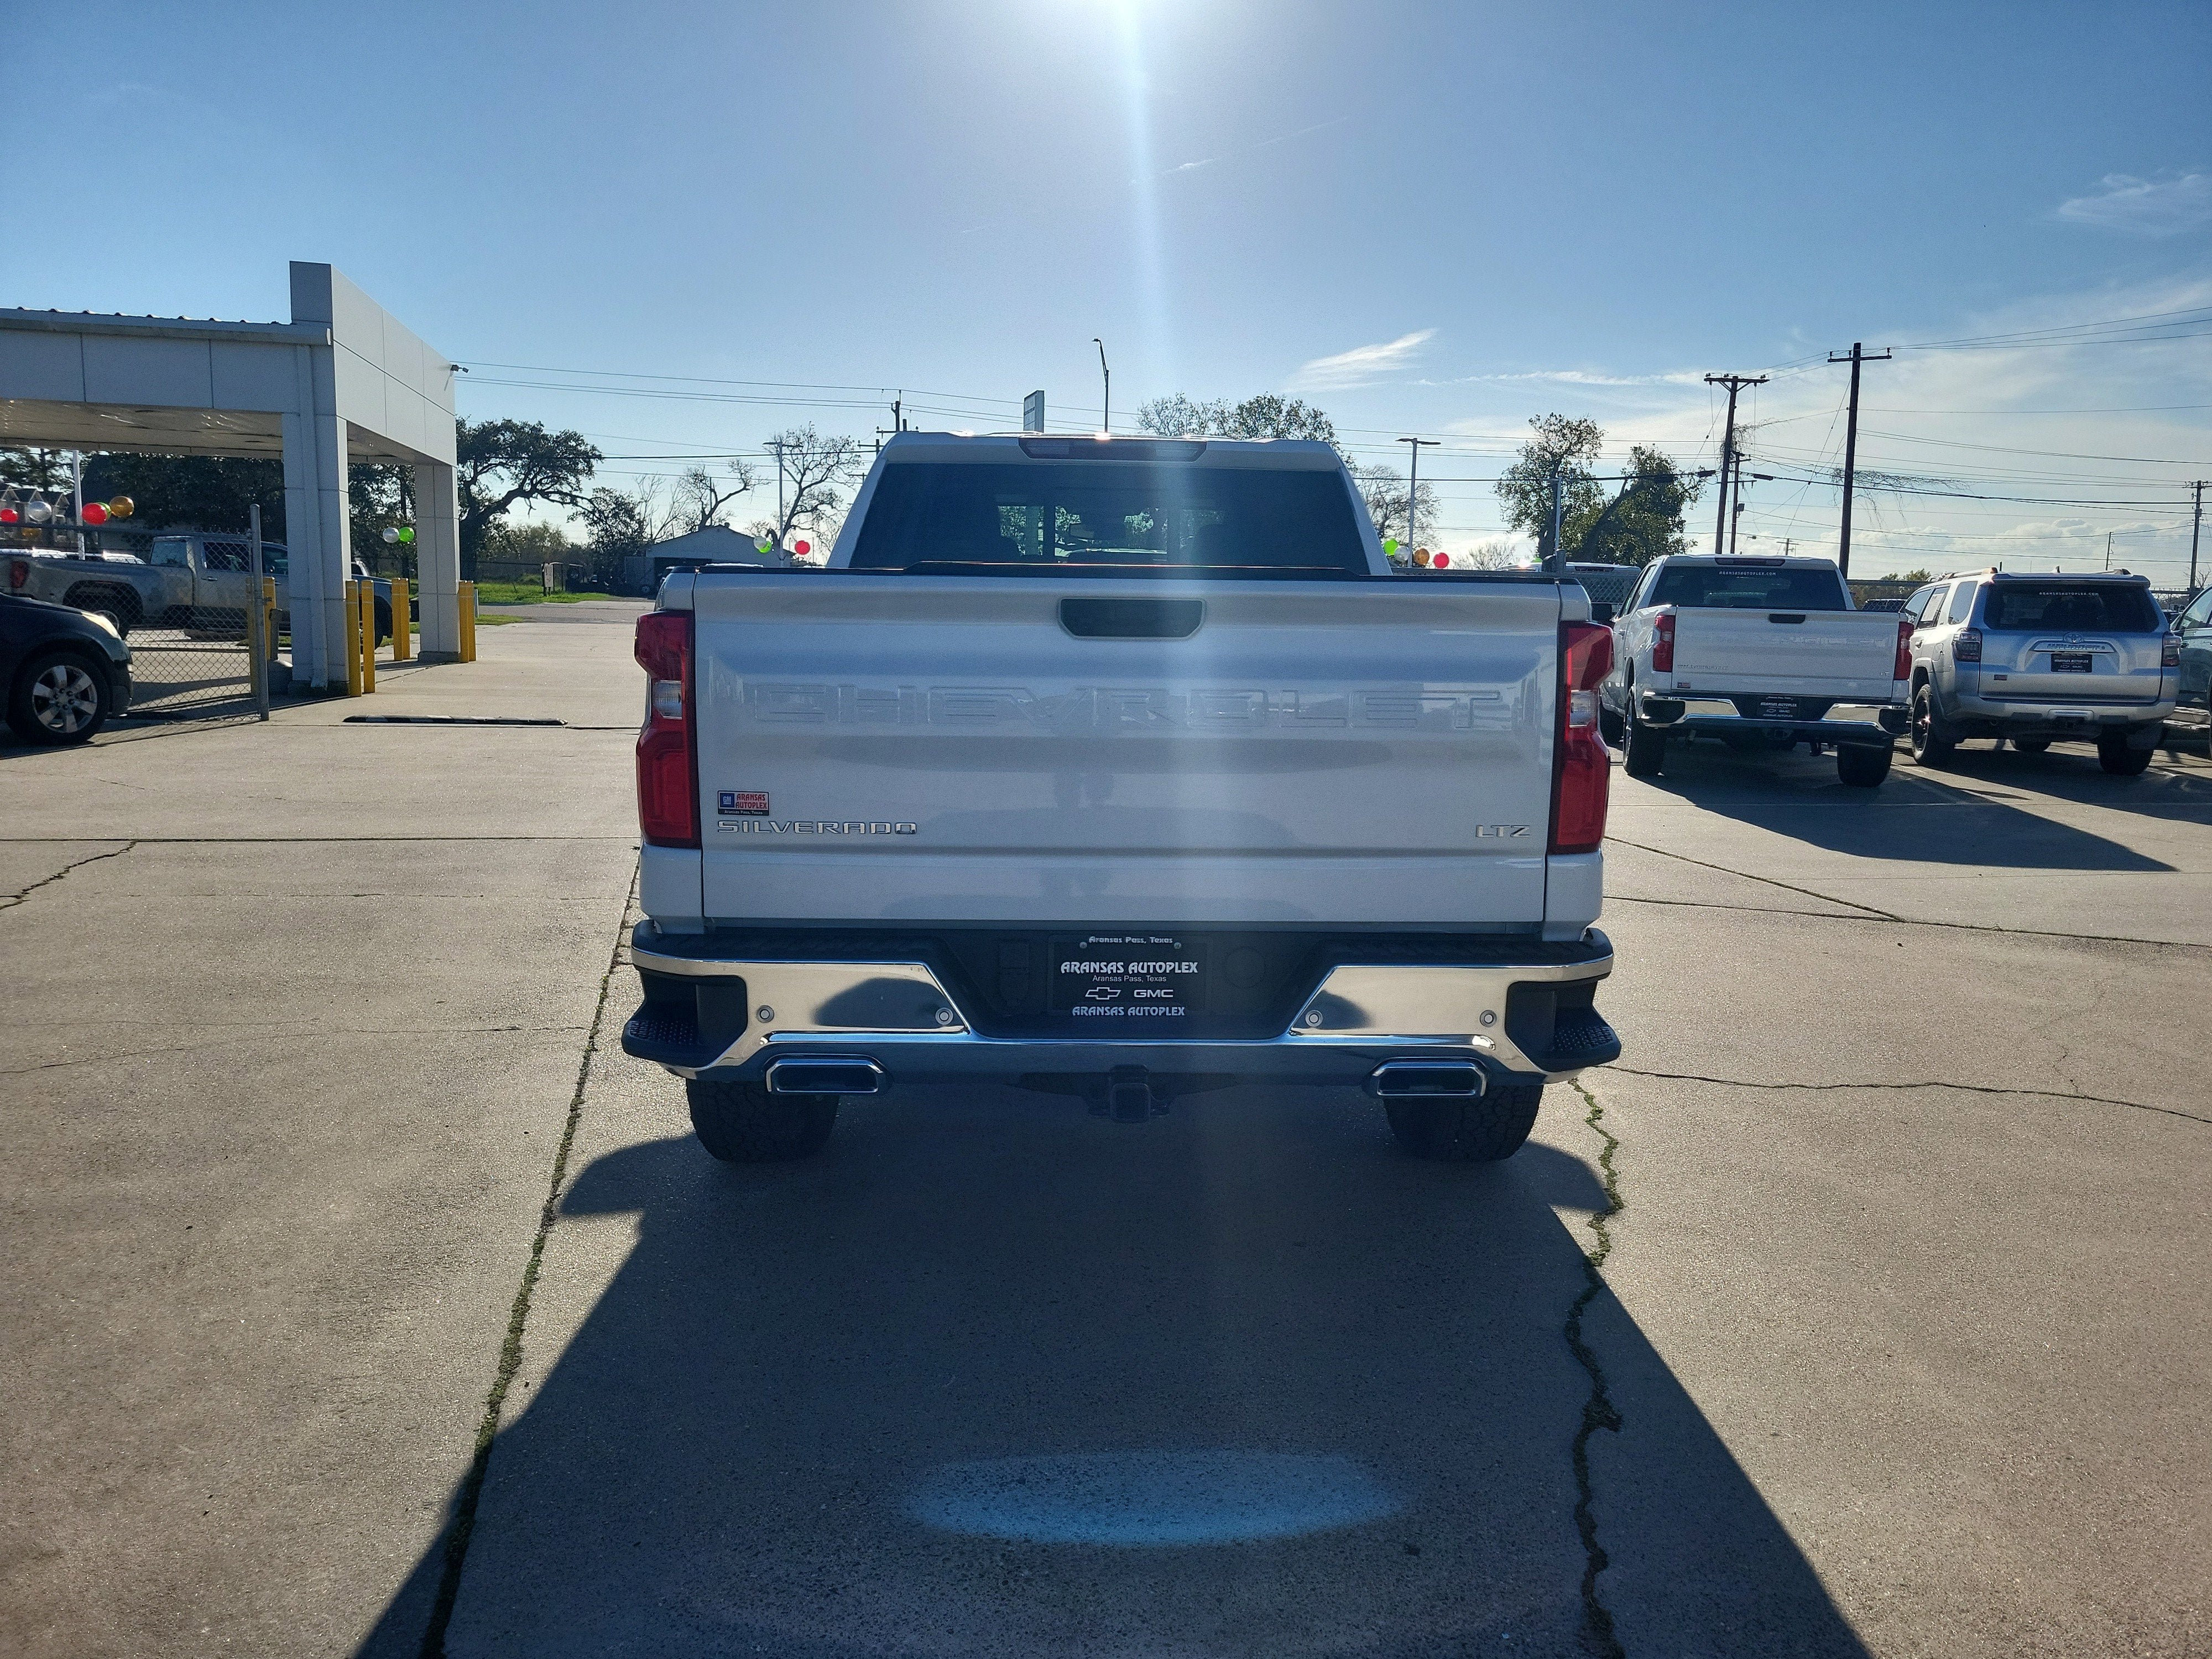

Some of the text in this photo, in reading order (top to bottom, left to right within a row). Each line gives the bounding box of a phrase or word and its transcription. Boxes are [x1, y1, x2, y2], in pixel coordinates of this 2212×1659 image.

[754, 684, 1501, 728] CHEVROLET
[723, 795, 732, 805] GM
[718, 820, 917, 835] SILVERADO
[1475, 825, 1531, 838] LTZ
[1125, 936, 1147, 945] Pass,
[1061, 962, 1198, 974] ARANSAS AUTOPLEX
[1134, 989, 1173, 998] GMC
[1072, 1006, 1185, 1016] ARANSAS AUTOPLEX
